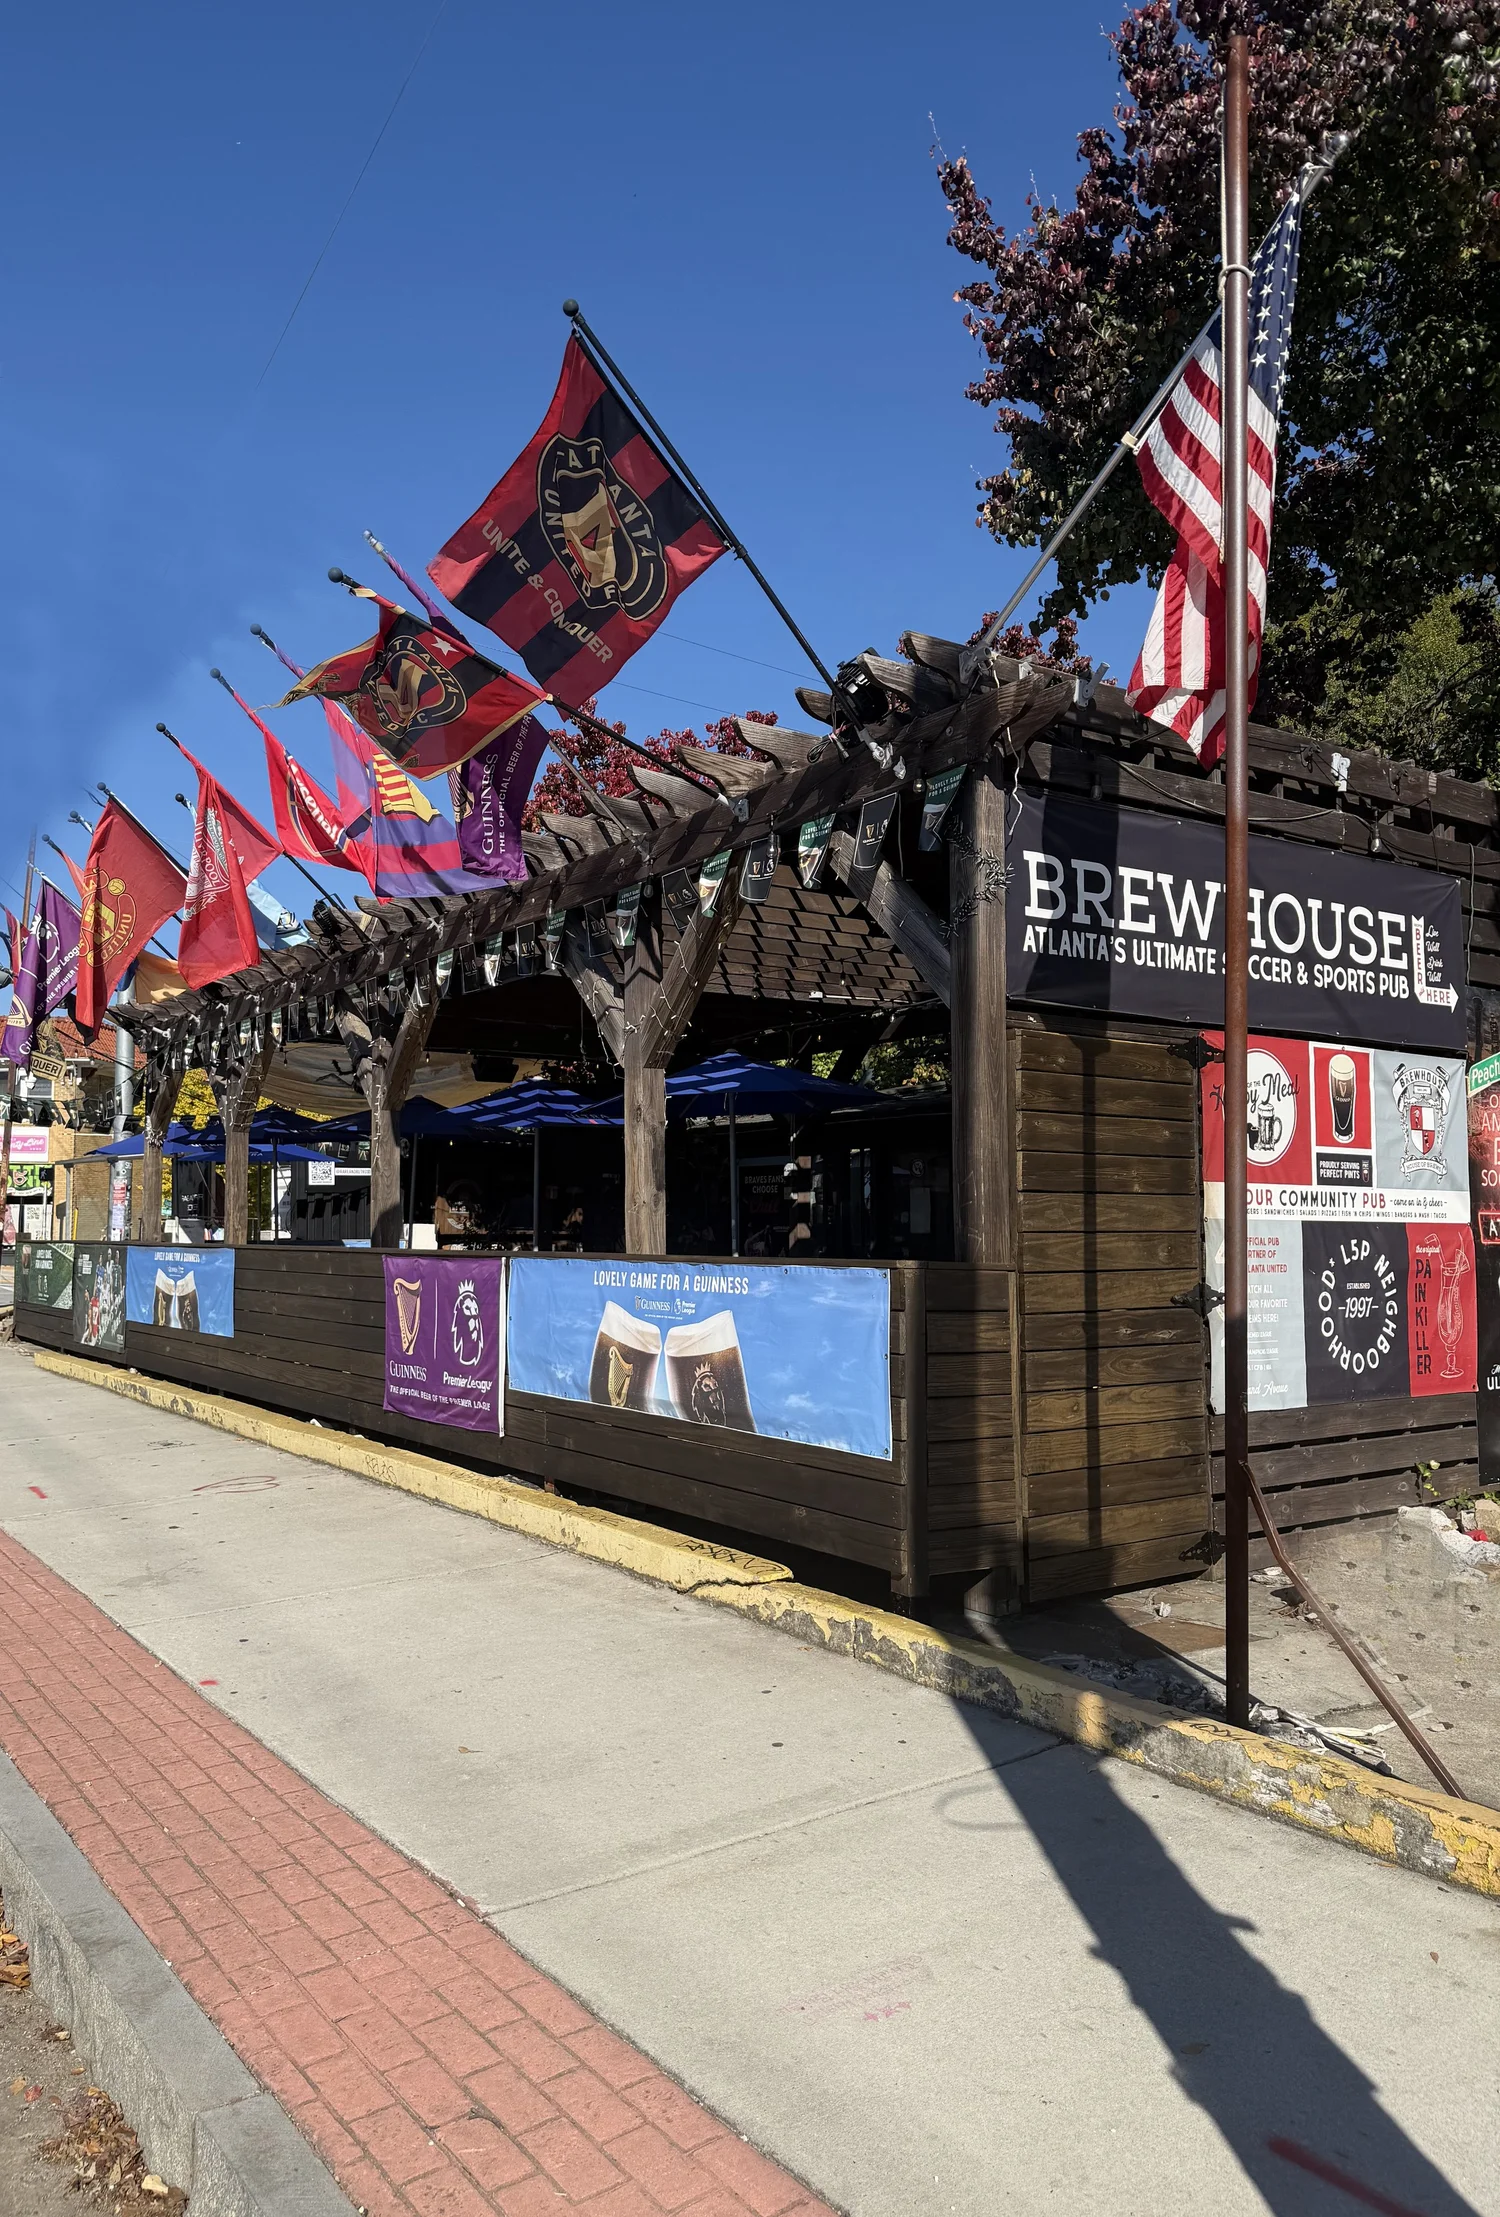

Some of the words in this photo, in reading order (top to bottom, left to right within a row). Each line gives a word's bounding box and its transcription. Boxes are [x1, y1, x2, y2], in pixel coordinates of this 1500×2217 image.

[568, 445, 657, 558] ATANTA
[482, 519, 531, 574] UNITE
[527, 573, 544, 590] &
[543, 588, 613, 664] CONQUER
[499, 776, 511, 827] OFFICIAL
[506, 750, 520, 773] BEER
[515, 740, 523, 750] OF
[519, 722, 529, 740] THE
[481, 753, 498, 855] GUINNESS
[1023, 924, 1126, 964] ATLANTA'S
[1133, 939, 1216, 975] ULTIMATE
[1222, 958, 1292, 984] CCER
[1297, 965, 1309, 984] &
[1313, 964, 1375, 995] SPORTS
[1380, 972, 1409, 999] PUB
[1415, 928, 1423, 985] BEER
[37, 965, 62, 992] Premier
[1426, 989, 1451, 1004] HERE
[32, 1056, 59, 1074] QUER
[1262, 1072, 1300, 1105] Meal
[1400, 1069, 1446, 1094] BREWHOUSE
[744, 1175, 767, 1184] BRAVES
[1319, 1169, 1343, 1178] PERFECT
[1344, 1170, 1360, 1179] PINTS
[752, 1185, 778, 1194] CHOOSE
[1279, 1190, 1357, 1208] COMMUNITY
[1363, 1193, 1386, 1209] PUB
[1264, 1208, 1295, 1216] SANDWICHES
[1247, 1237, 1266, 1246] FICIAL
[1267, 1237, 1280, 1246] PUB
[1247, 1250, 1266, 1258] RTNER
[1267, 1250, 1277, 1259] OF
[1340, 1239, 1370, 1265] L5P
[1247, 1264, 1265, 1273] LANTA
[1266, 1264, 1288, 1273] UNITED
[593, 1270, 627, 1287] LOVELY
[630, 1272, 658, 1289] GAME
[660, 1274, 680, 1290] FOR
[683, 1275, 690, 1291] A
[693, 1276, 749, 1295] GUINNESS
[1248, 1285, 1262, 1294] ATCH
[1263, 1285, 1273, 1294] ALL
[641, 1298, 671, 1311] GUINNESS
[682, 1300, 696, 1308] Premier
[1248, 1300, 1259, 1309] OUR
[1260, 1299, 1288, 1308] FAVORITE
[389, 1360, 427, 1382] GUINNESS
[443, 1371, 467, 1387] Premier
[390, 1385, 399, 1394] THE
[399, 1388, 420, 1398] OFFICIAL
[420, 1391, 431, 1401] BEER
[432, 1394, 438, 1402] OF
[439, 1395, 449, 1404] THE
